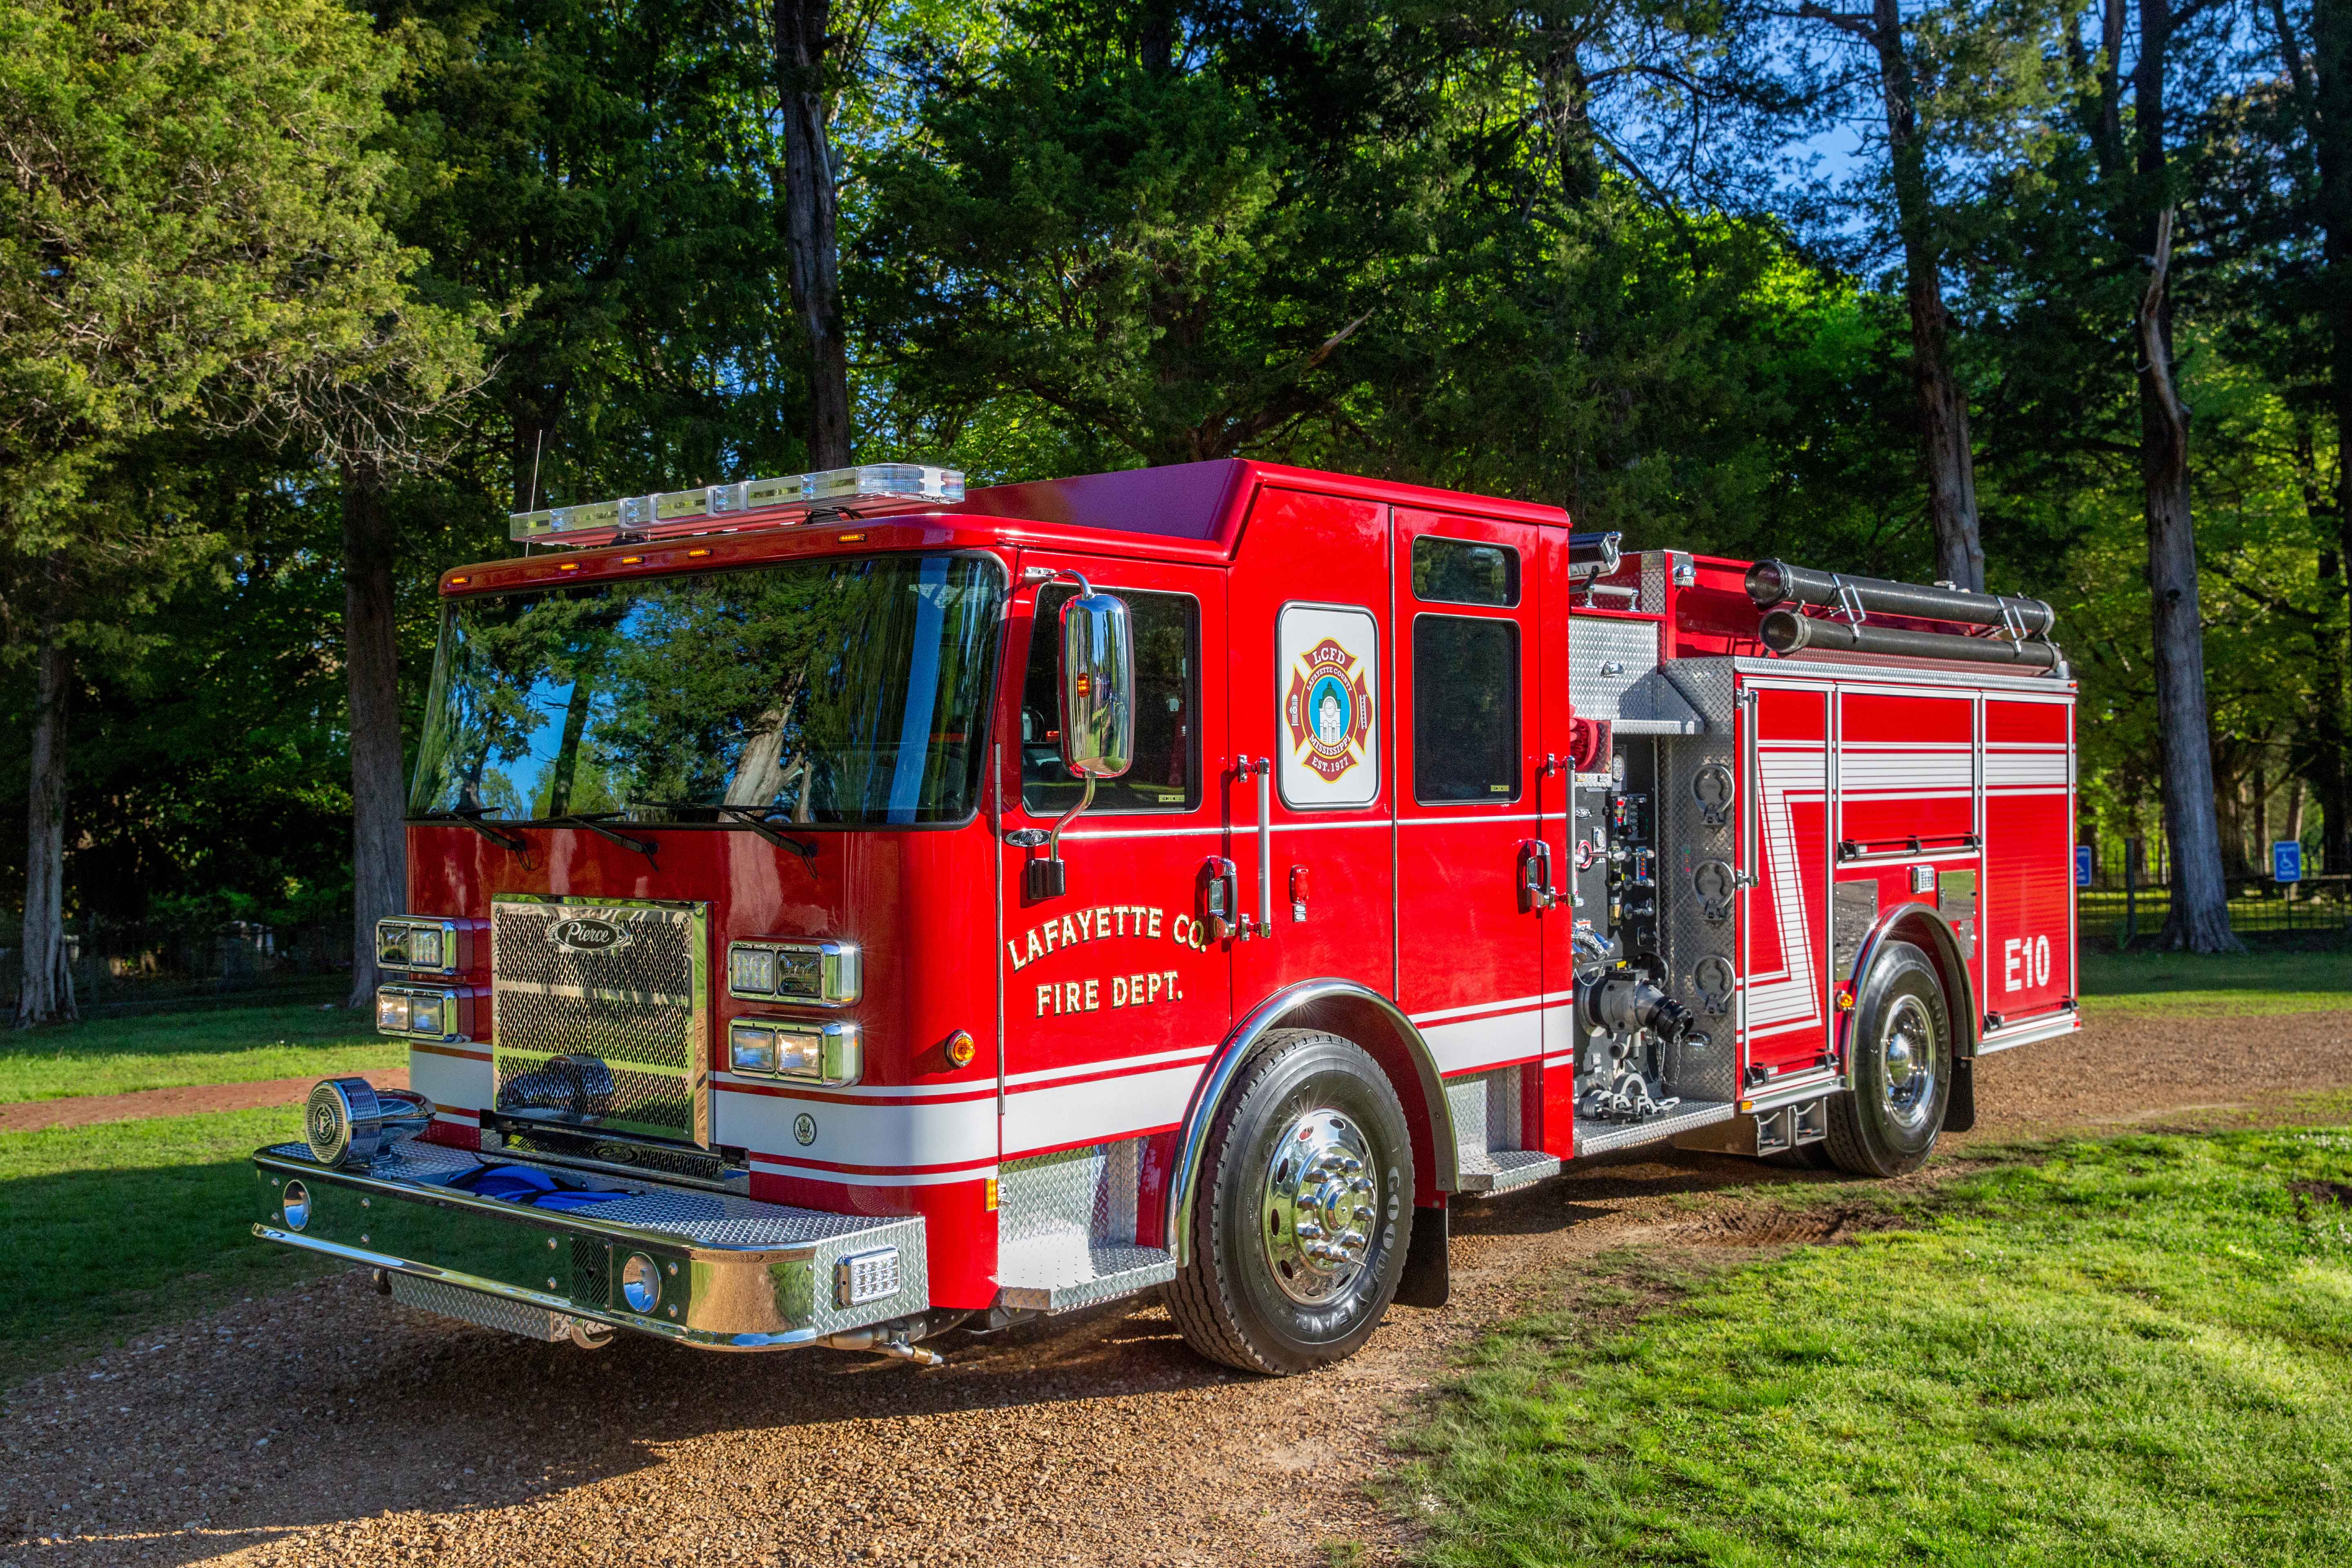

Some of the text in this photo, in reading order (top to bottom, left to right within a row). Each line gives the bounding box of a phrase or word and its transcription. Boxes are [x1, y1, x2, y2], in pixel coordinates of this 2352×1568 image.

[1312, 647, 1345, 664] LCFD
[1307, 667, 1353, 692] LAFAYETTE COUNTY
[1309, 733, 1352, 755] MISSISSIPPI
[566, 922, 610, 943] Pierce
[1007, 906, 1207, 973] LAFAYETTE CO.
[2005, 934, 2050, 992] E10
[1035, 970, 1183, 1018] FIRE DEPT.
